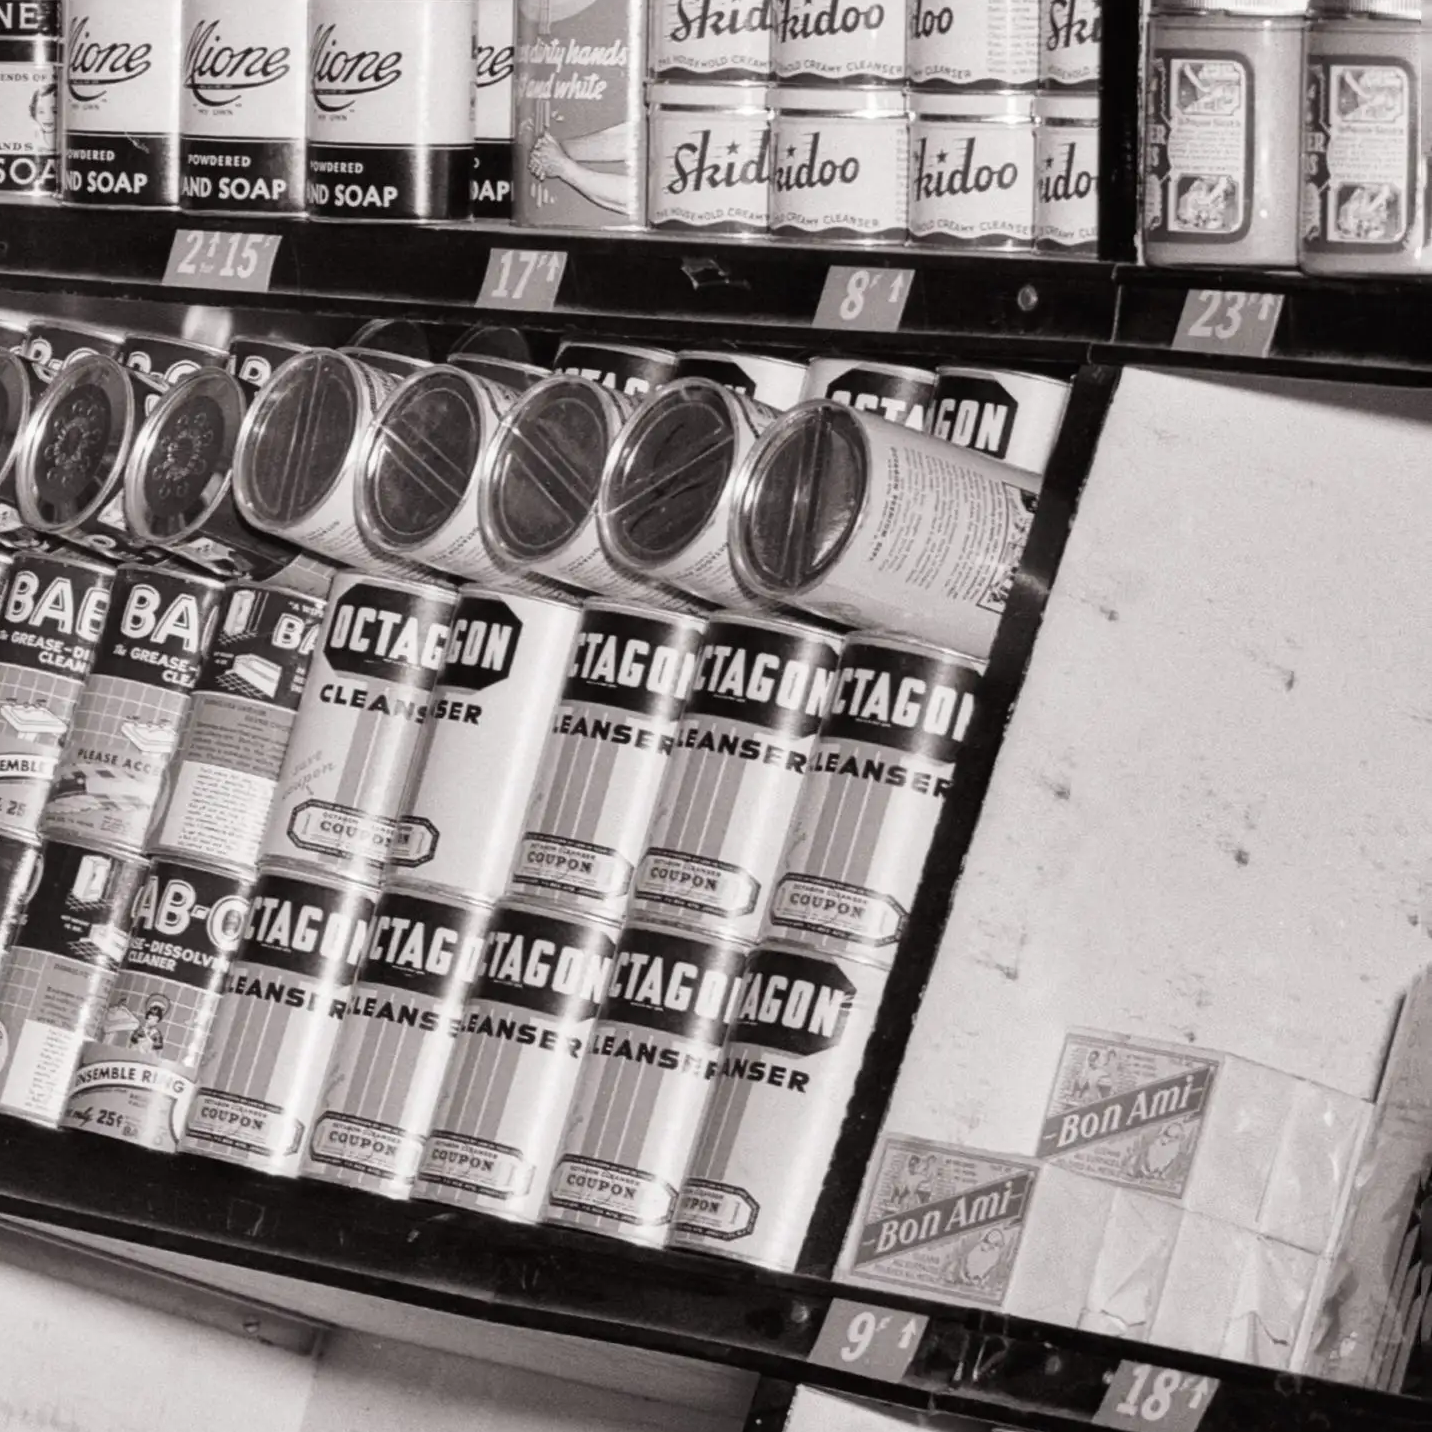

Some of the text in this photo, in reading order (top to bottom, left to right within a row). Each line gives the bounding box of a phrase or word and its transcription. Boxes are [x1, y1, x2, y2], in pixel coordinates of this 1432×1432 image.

[188, 155, 251, 168] POWDERED
[220, 180, 286, 199] SOAP
[334, 604, 448, 667] OCTAG
[528, 849, 592, 875] COUPON
[789, 892, 866, 921] COUPON
[1056, 1076, 1193, 1147] Bon Ami
